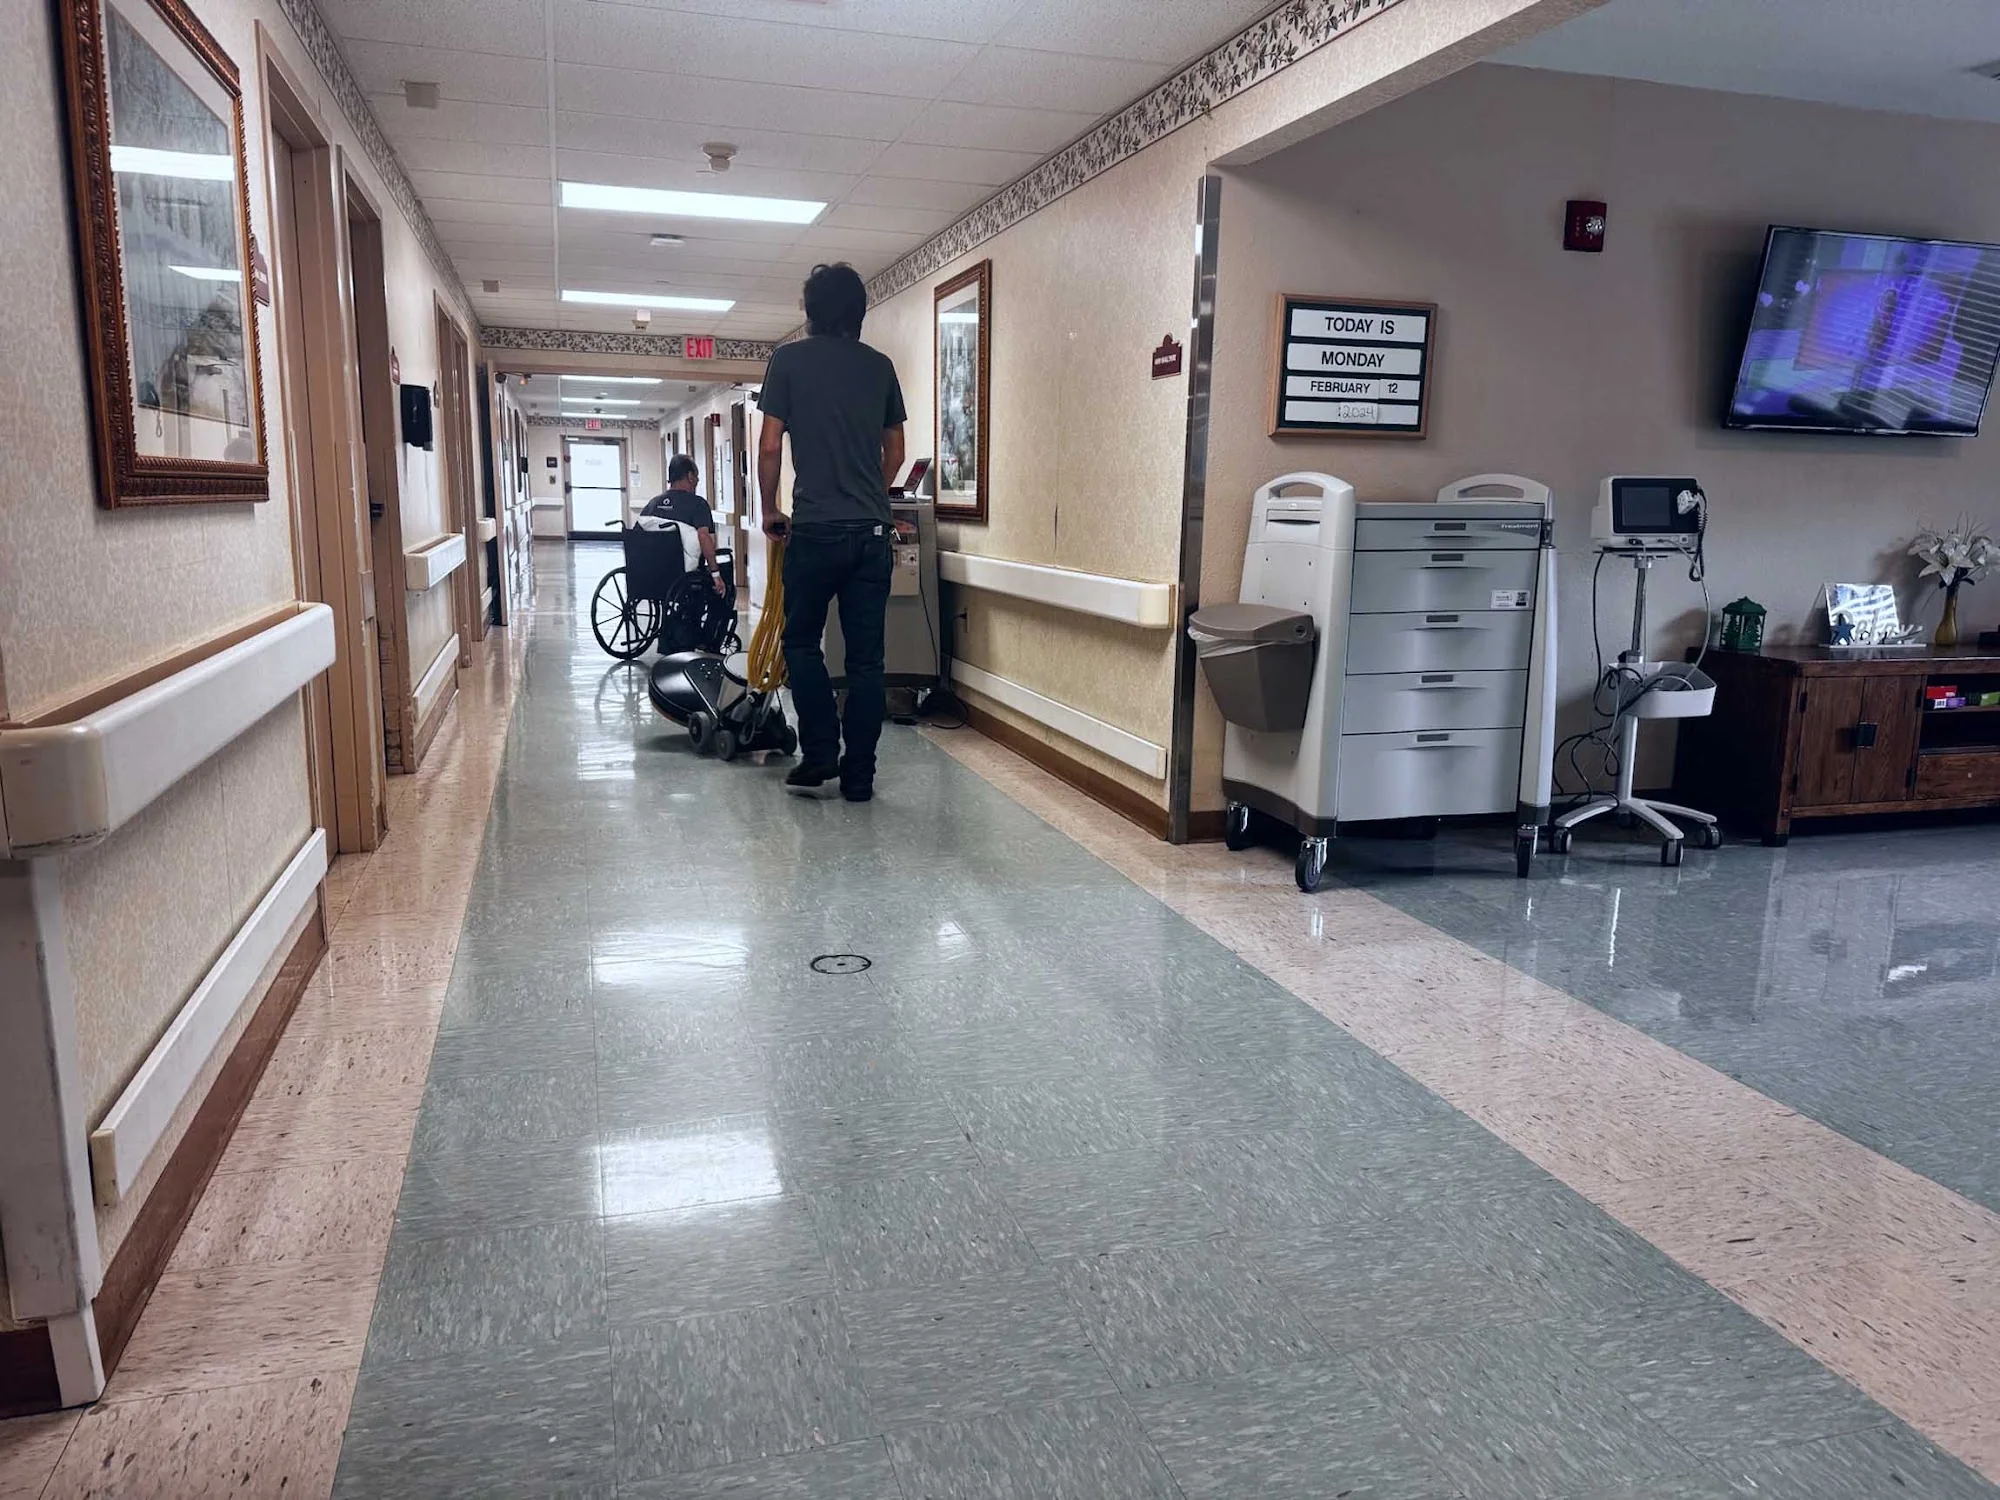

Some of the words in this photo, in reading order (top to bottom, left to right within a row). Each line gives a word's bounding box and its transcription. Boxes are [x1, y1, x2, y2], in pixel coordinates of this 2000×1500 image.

[1325, 316, 1374, 334] TODAY
[1380, 319, 1395, 335] IS
[686, 336, 714, 360] EXIT
[1321, 350, 1385, 368] MONDAY
[1310, 380, 1371, 394] FEBRUARY
[1387, 382, 1399, 394] 12
[1342, 405, 1376, 420] 2024
